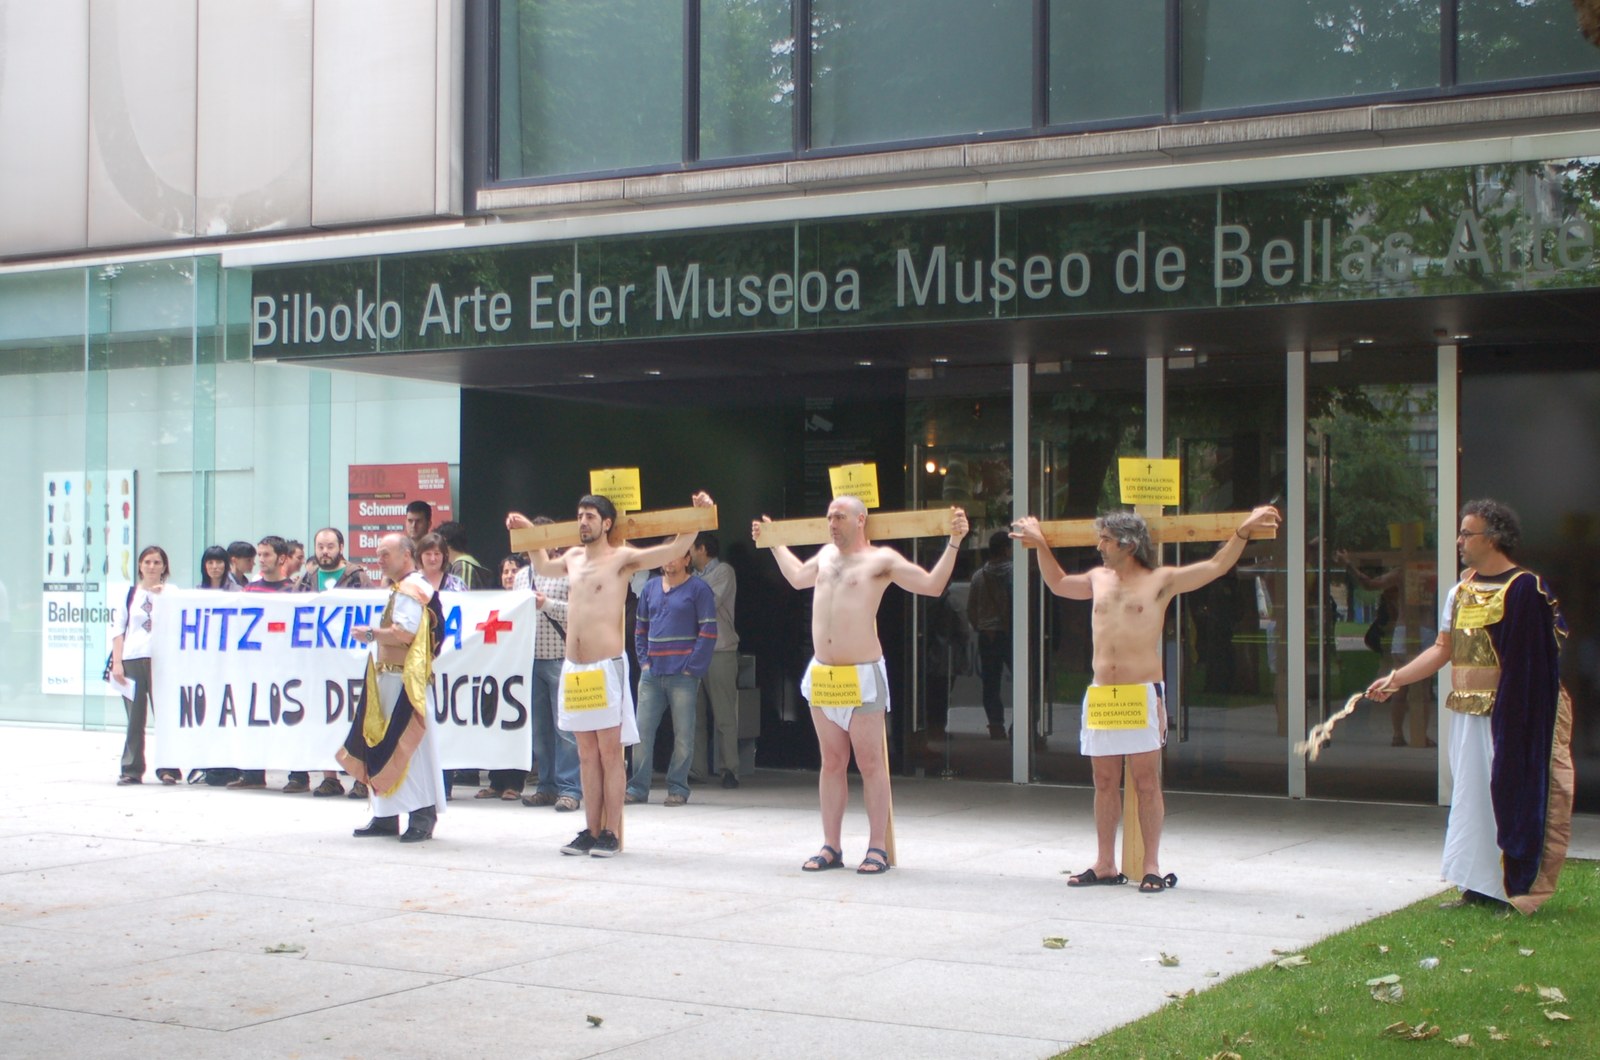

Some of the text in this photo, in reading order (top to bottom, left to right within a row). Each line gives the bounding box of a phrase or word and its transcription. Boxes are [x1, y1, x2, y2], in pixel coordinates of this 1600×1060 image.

[253, 289, 401, 346] Bilboko
[418, 282, 512, 336] Arte
[530, 273, 636, 330] Eder
[655, 263, 861, 321] Museoa
[896, 246, 1091, 307] Museo
[1115, 231, 1186, 294] de
[1214, 218, 1414, 288] Bellas
[180, 684, 206, 728] NO
[218, 684, 237, 727] A
[248, 678, 304, 726] LOS
